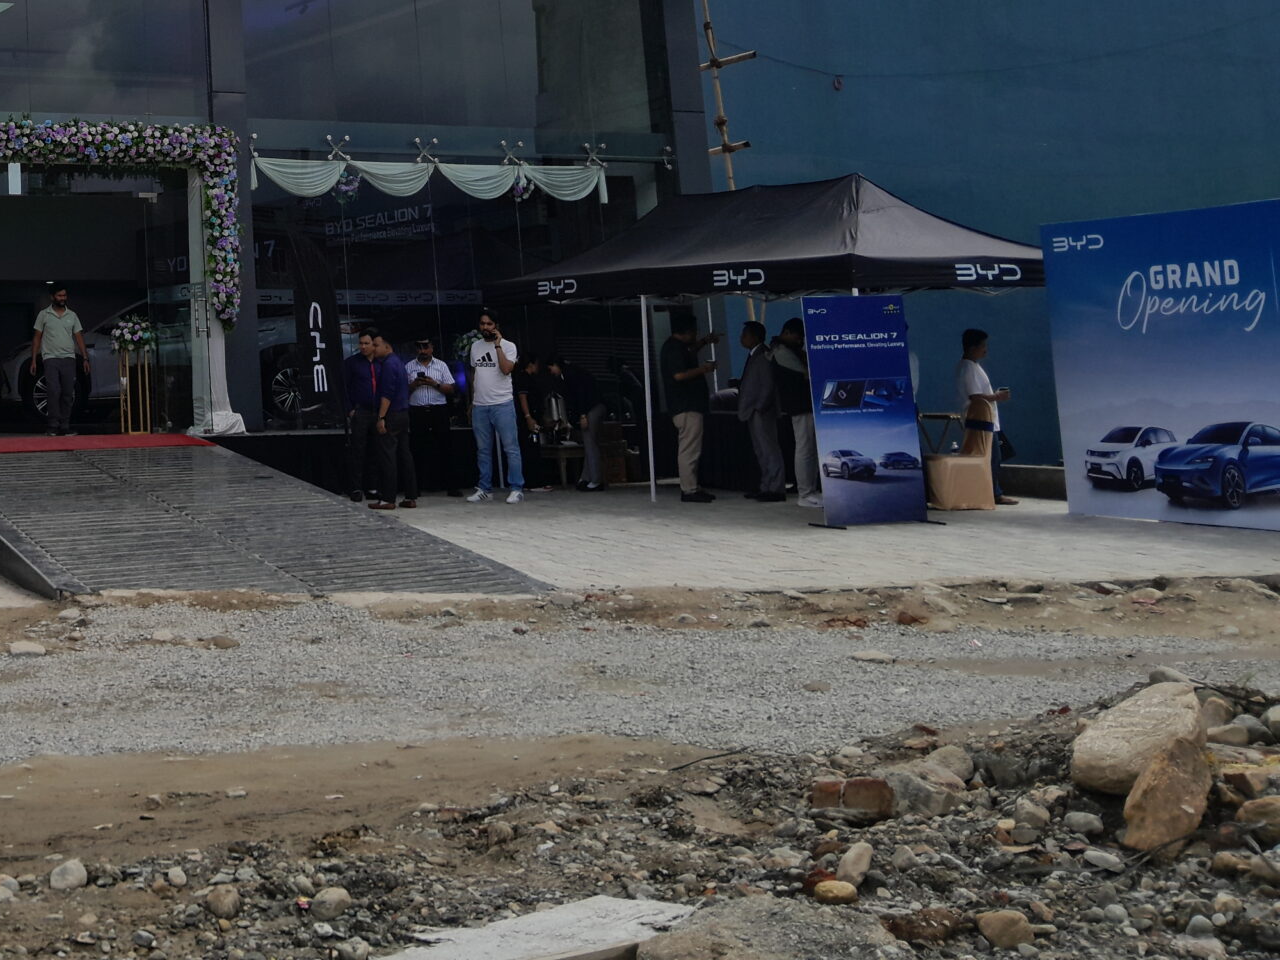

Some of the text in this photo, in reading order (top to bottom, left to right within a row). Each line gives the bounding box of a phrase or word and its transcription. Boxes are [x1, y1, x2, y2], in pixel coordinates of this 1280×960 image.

[325, 204, 432, 235] BYD SEALION 7
[1052, 234, 1104, 252] BYD
[713, 268, 766, 287] BYD
[955, 263, 1021, 281] BYD
[1149, 259, 1240, 290] GRAND
[536, 279, 578, 296] BYD
[356, 293, 389, 302] BYD
[396, 292, 434, 302] BYD
[1117, 271, 1266, 334] Opening
[815, 331, 898, 342] BYD SEALION 7
[309, 301, 328, 393] BYD
